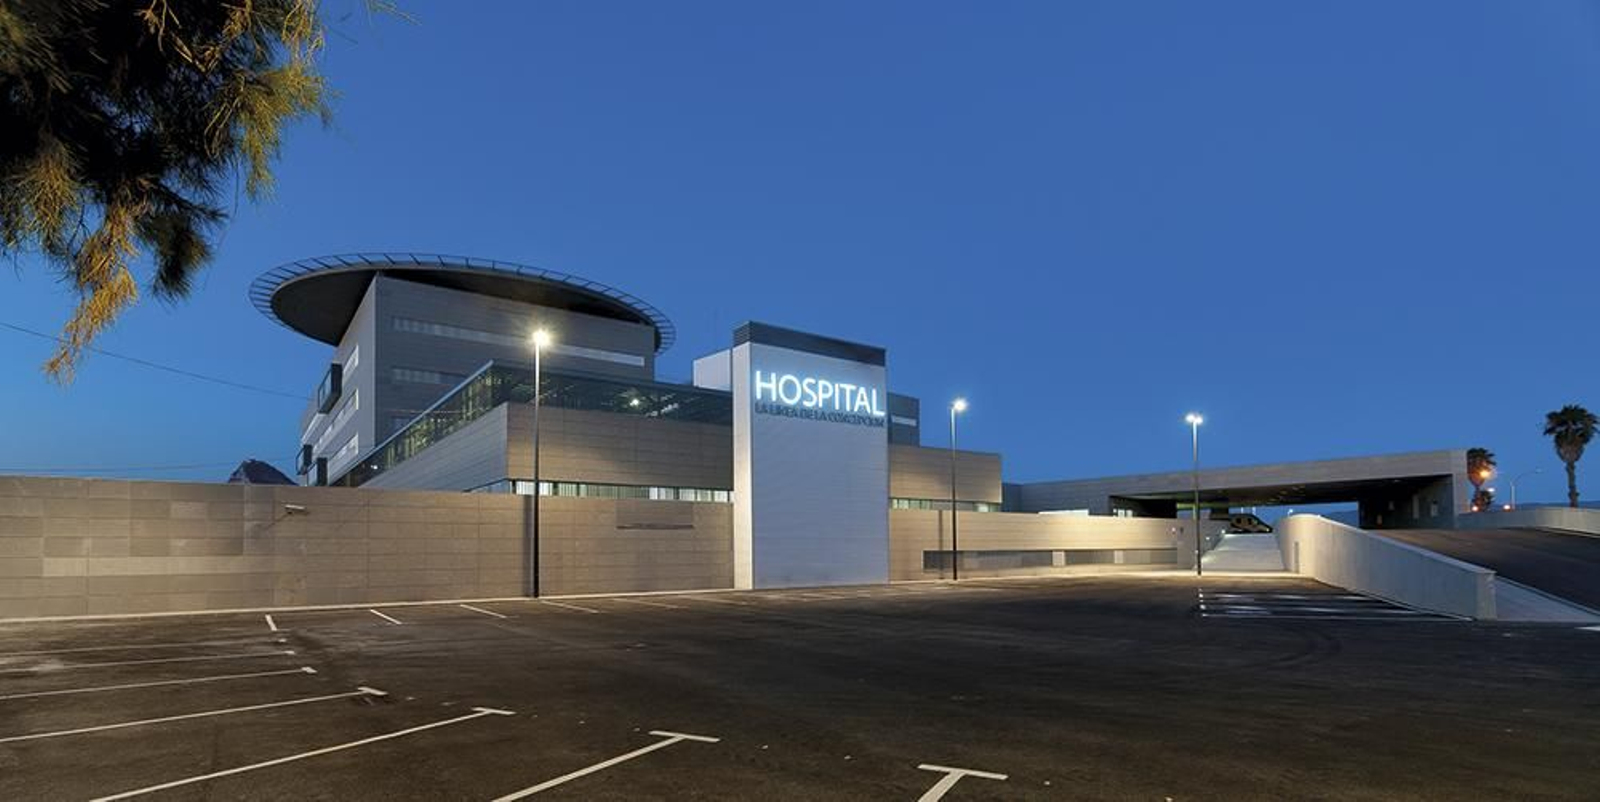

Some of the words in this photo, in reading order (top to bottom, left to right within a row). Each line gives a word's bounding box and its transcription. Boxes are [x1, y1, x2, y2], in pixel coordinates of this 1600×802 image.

[755, 371, 885, 416] HOSPITAL
[755, 402, 768, 414] LA
[814, 410, 827, 421] LA
